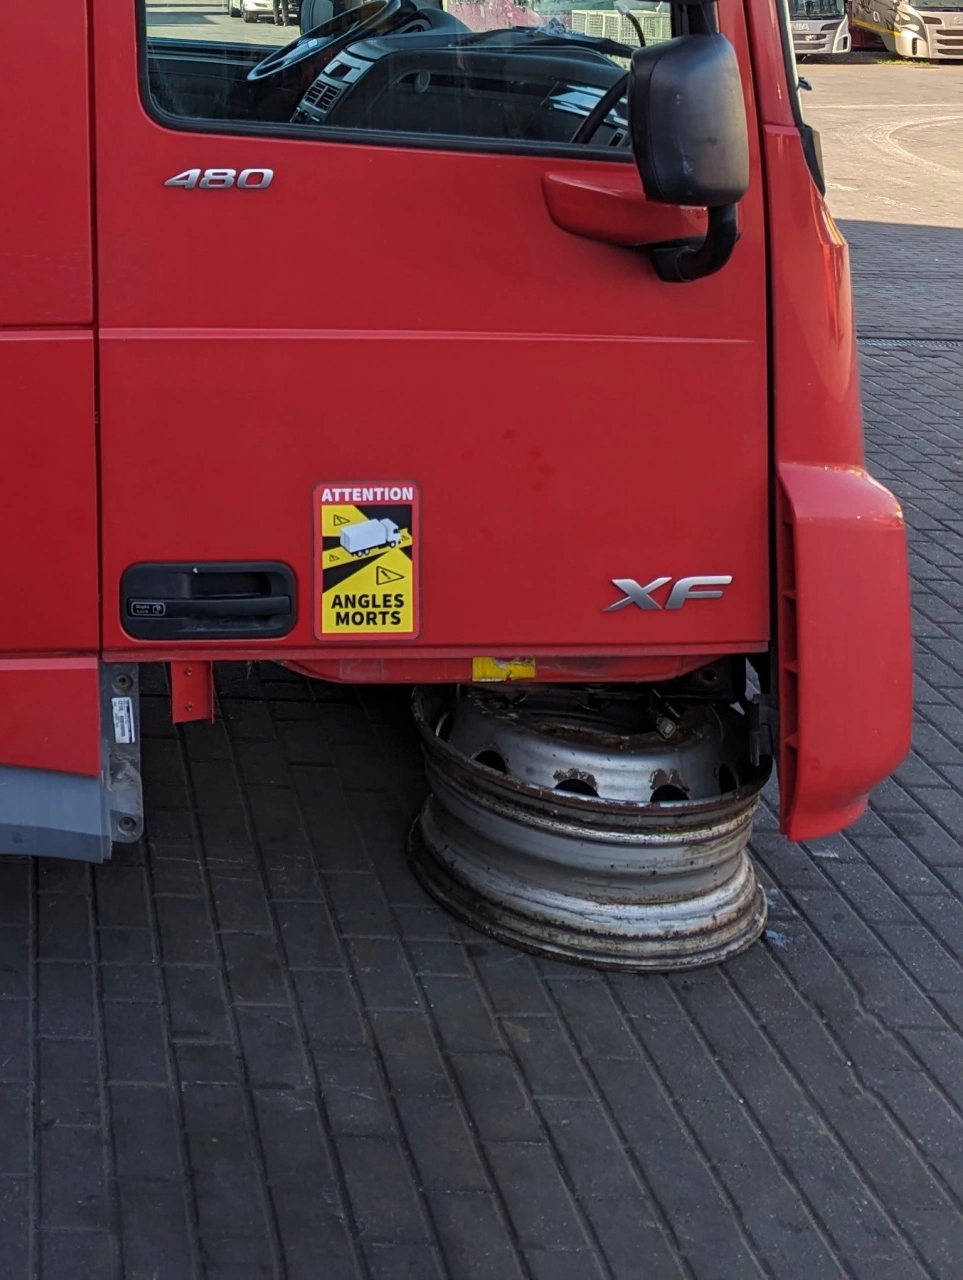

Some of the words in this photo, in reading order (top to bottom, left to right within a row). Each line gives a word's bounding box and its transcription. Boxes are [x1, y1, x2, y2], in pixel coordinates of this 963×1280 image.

[163, 168, 274, 189] 480
[321, 487, 414, 502] ATTENTION
[331, 593, 404, 609] ANGLES
[602, 575, 733, 611] XF
[335, 610, 401, 626] MORTS
